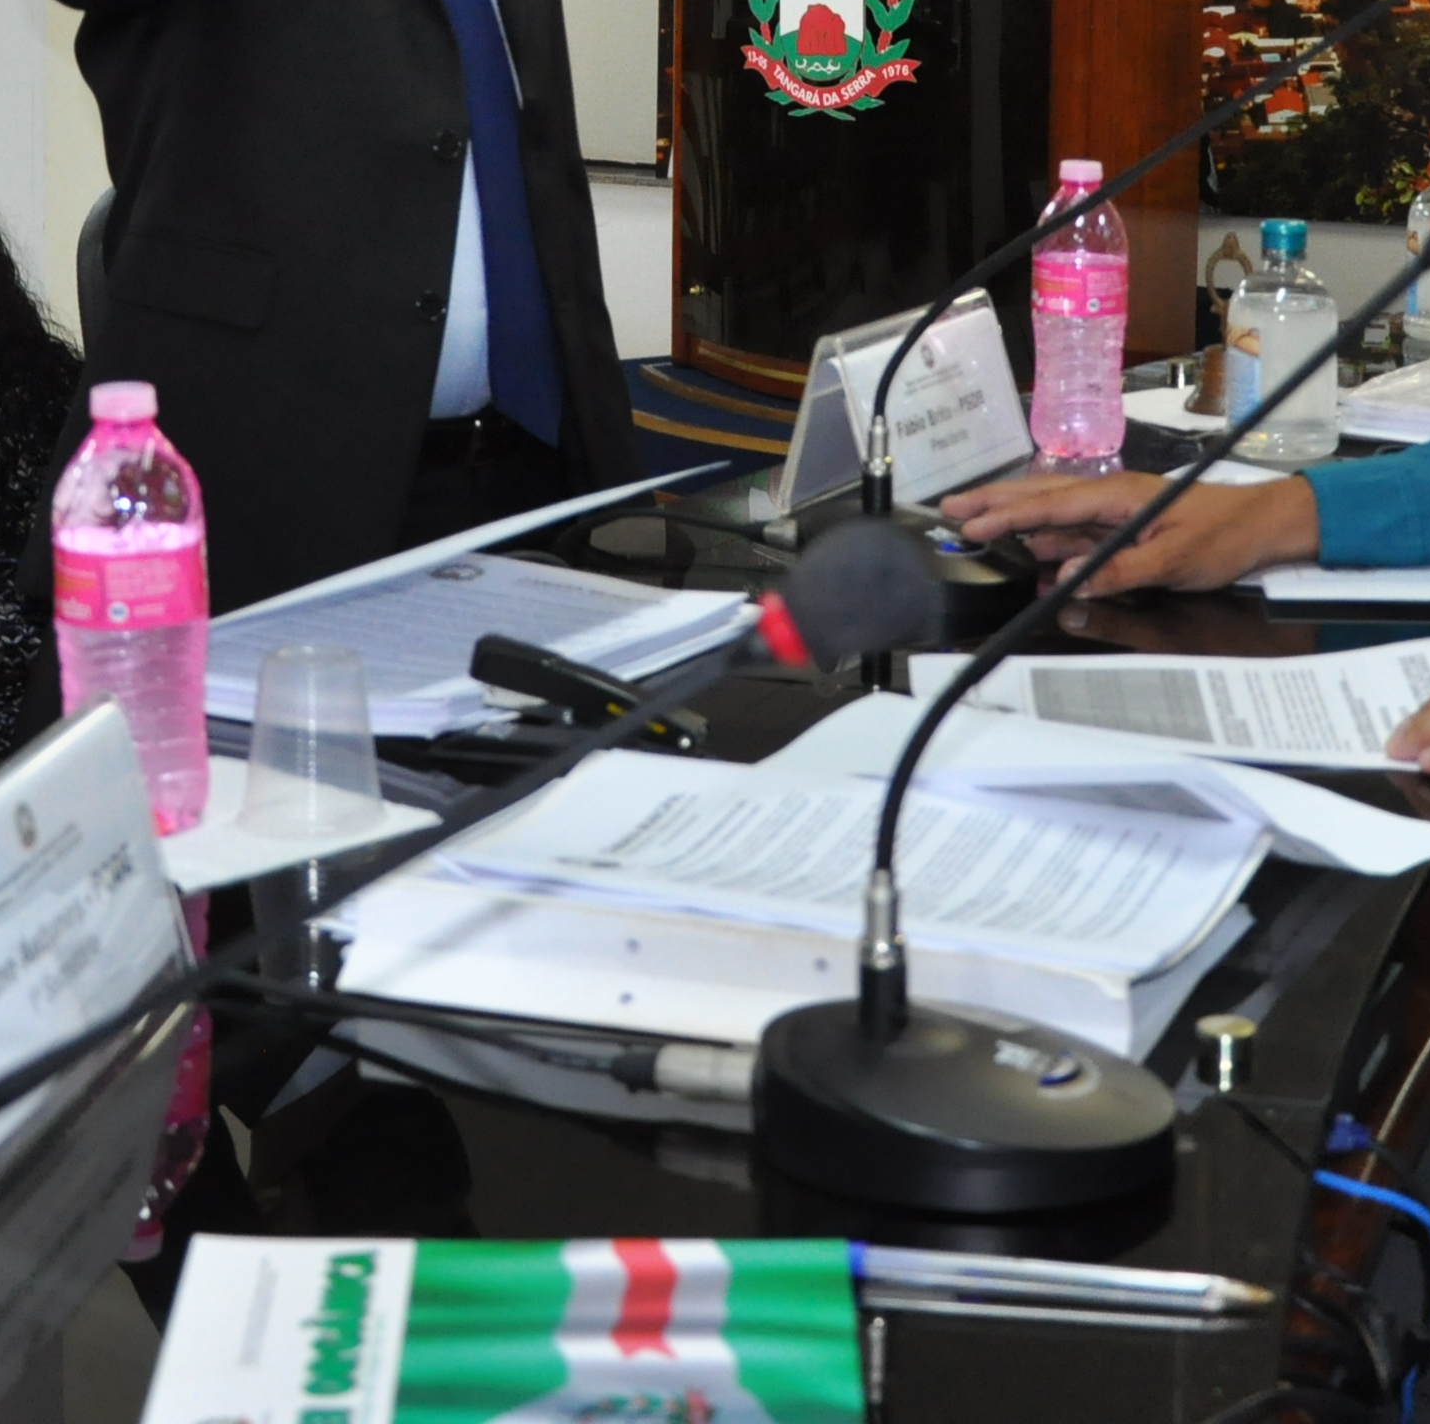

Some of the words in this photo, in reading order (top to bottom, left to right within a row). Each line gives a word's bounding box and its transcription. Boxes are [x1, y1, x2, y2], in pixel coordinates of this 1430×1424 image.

[773, 64, 821, 106] TANGARÁ
[822, 93, 841, 106] DA
[840, 69, 876, 100] SERRA
[882, 64, 910, 80] 1976
